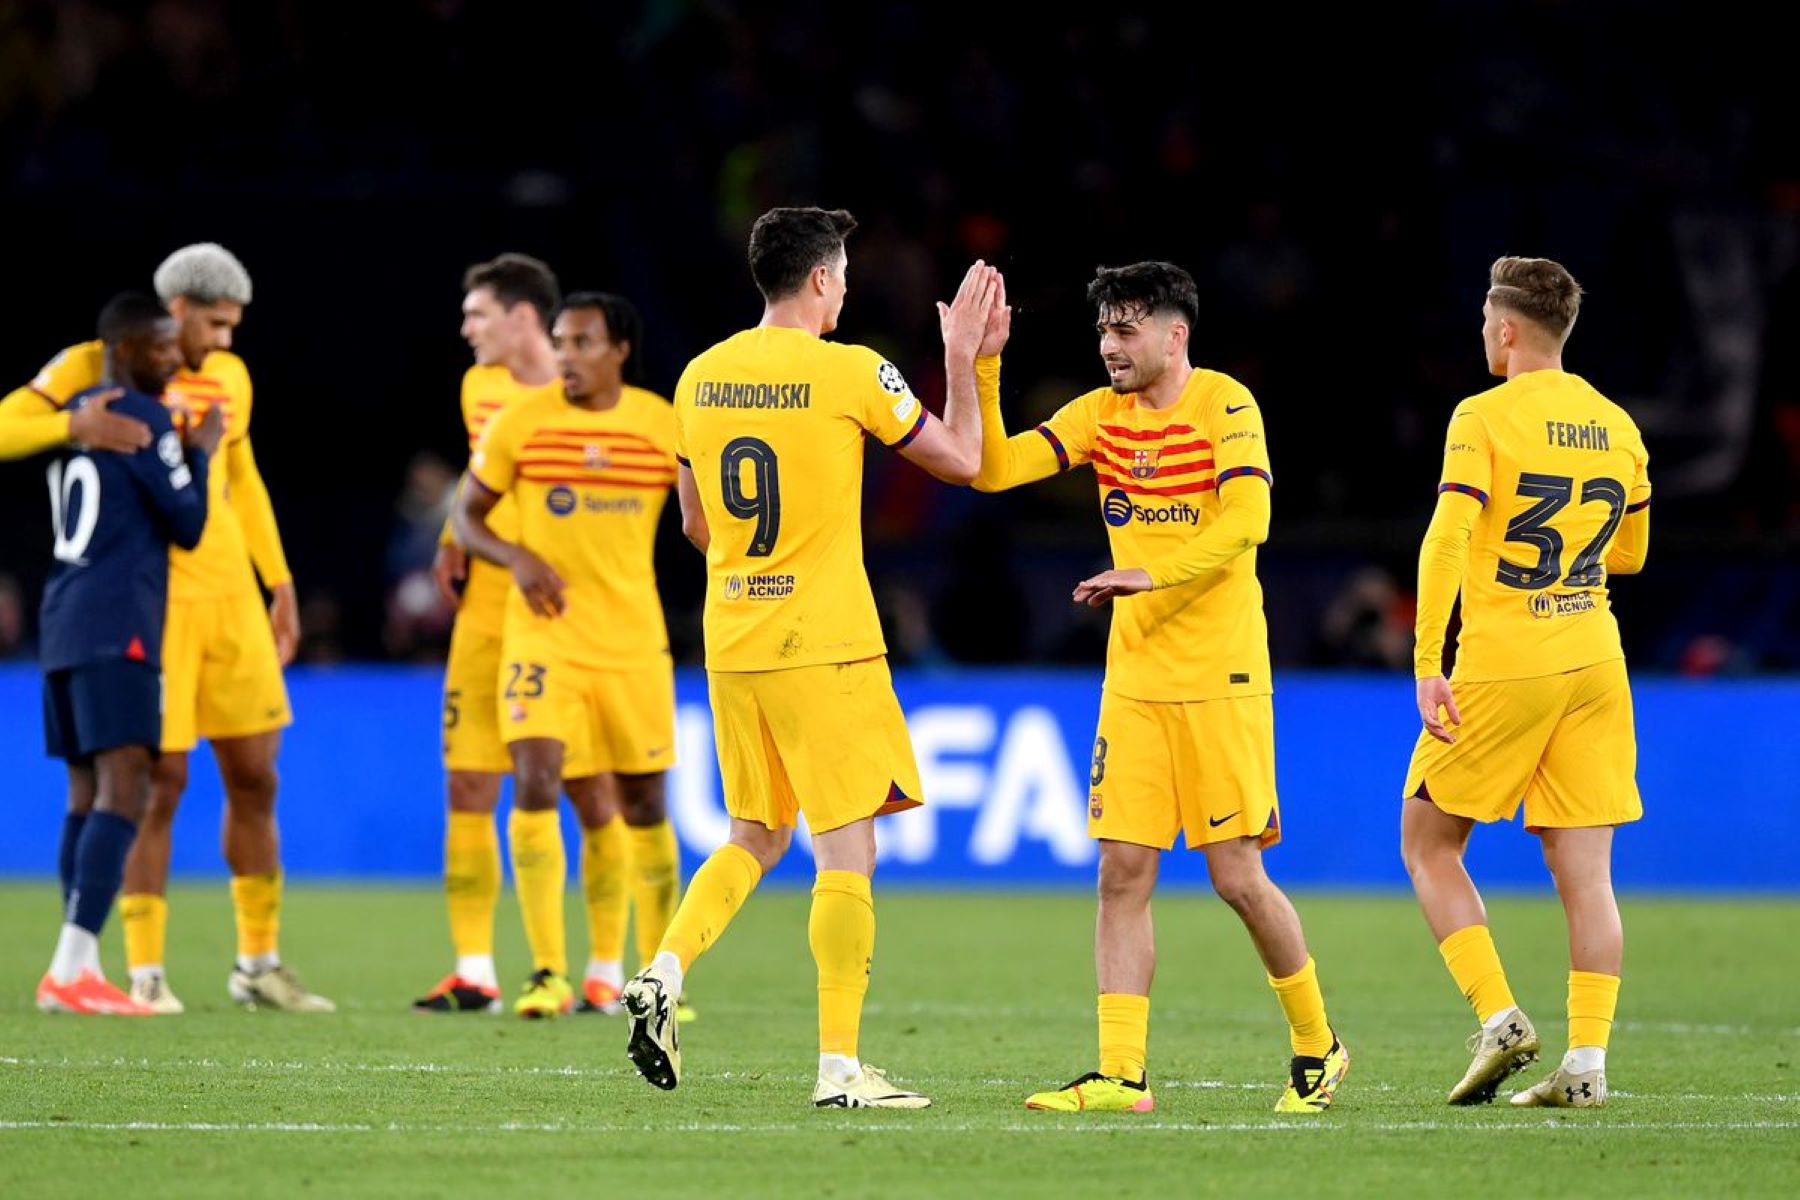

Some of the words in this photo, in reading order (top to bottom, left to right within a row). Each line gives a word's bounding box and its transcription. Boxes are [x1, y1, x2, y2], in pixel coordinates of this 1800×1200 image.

[694, 381, 810, 409] LEWANDOWSKI
[47, 455, 100, 567] 10
[721, 437, 780, 556] 9
[1133, 503, 1200, 526] Spotify
[1495, 472, 1626, 589] 32
[747, 575, 795, 585] UNHCR
[504, 663, 547, 699] 23
[1091, 736, 1107, 786] 8
